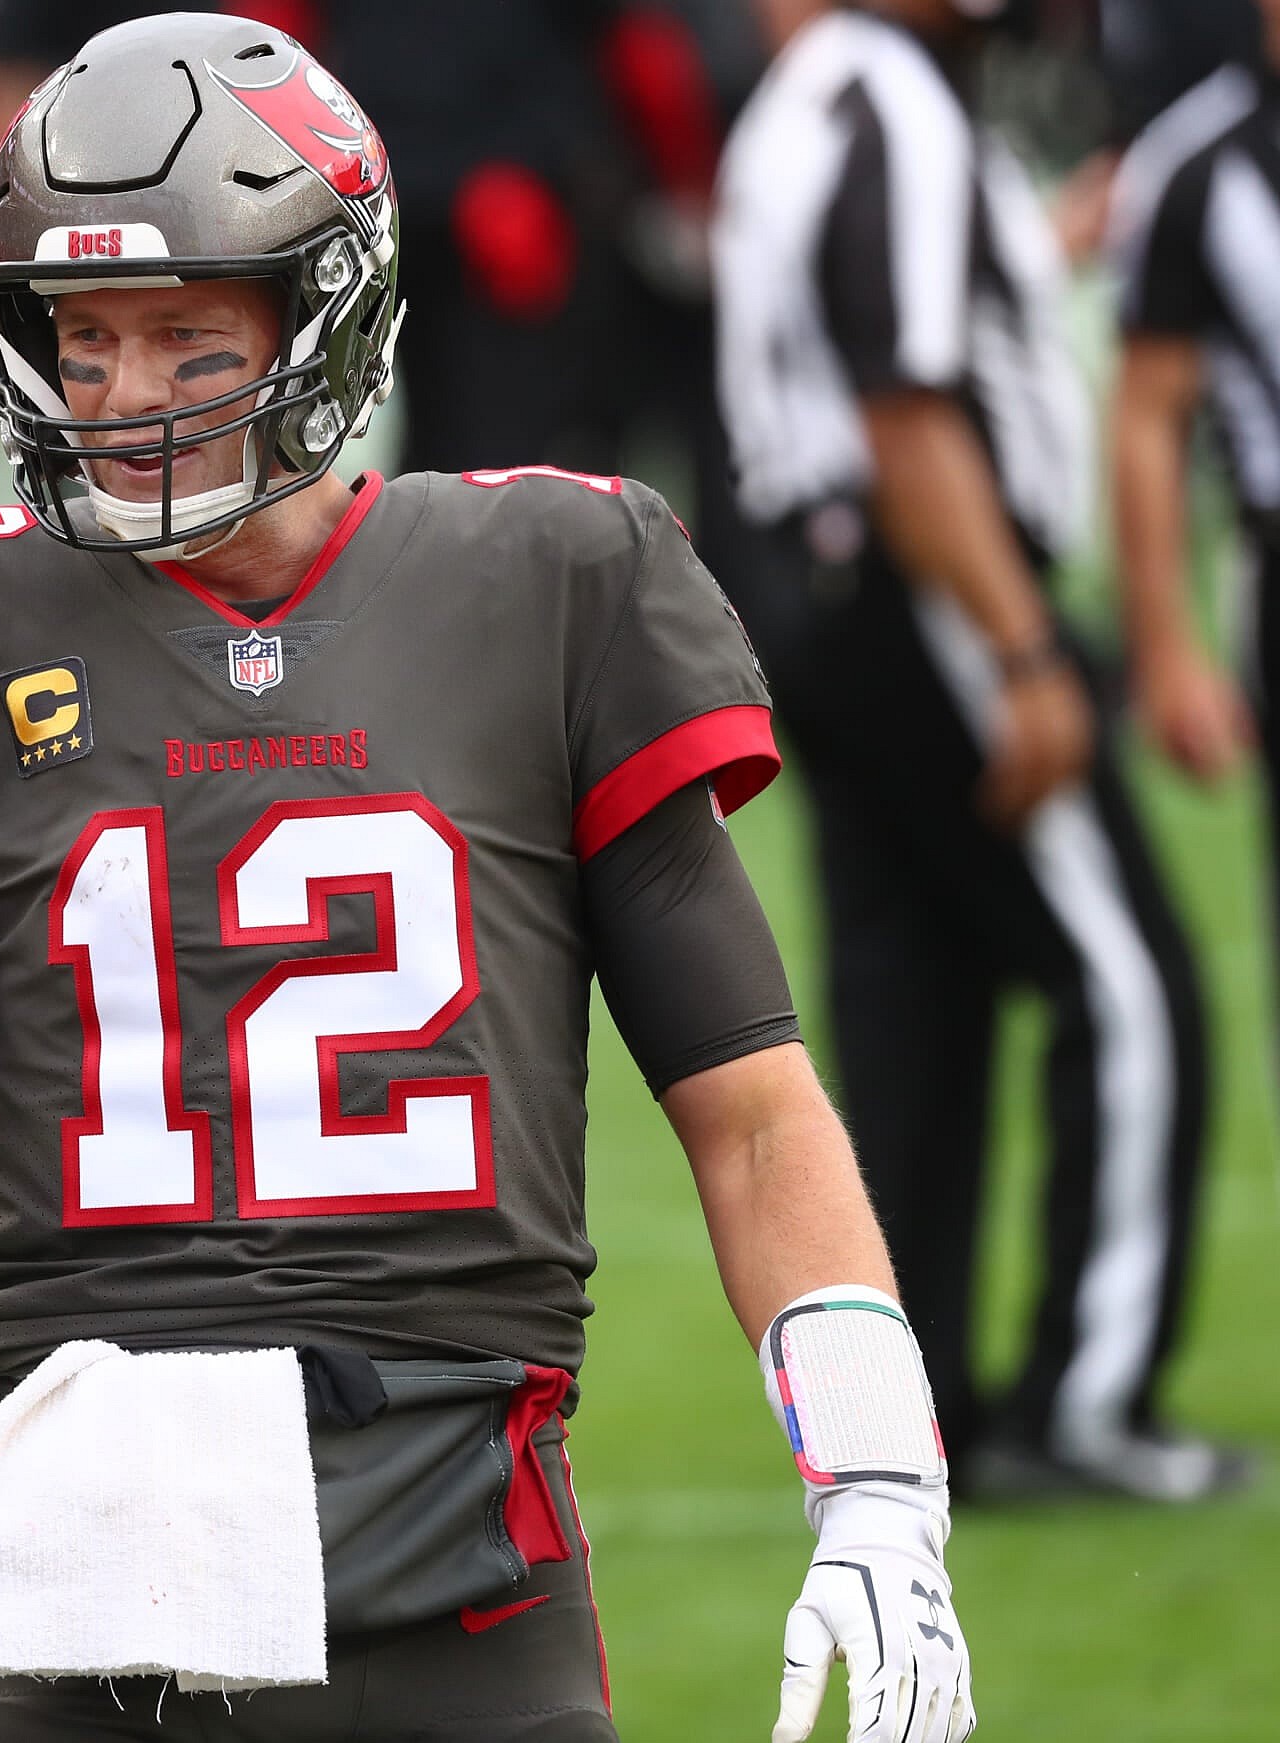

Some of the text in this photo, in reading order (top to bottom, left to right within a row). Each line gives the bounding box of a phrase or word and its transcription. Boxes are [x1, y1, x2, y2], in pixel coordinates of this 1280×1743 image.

[238, 659, 275, 684] NFL
[5, 667, 80, 746] C
[164, 728, 369, 777] BUCCANEERS
[47, 792, 497, 1228] 12
